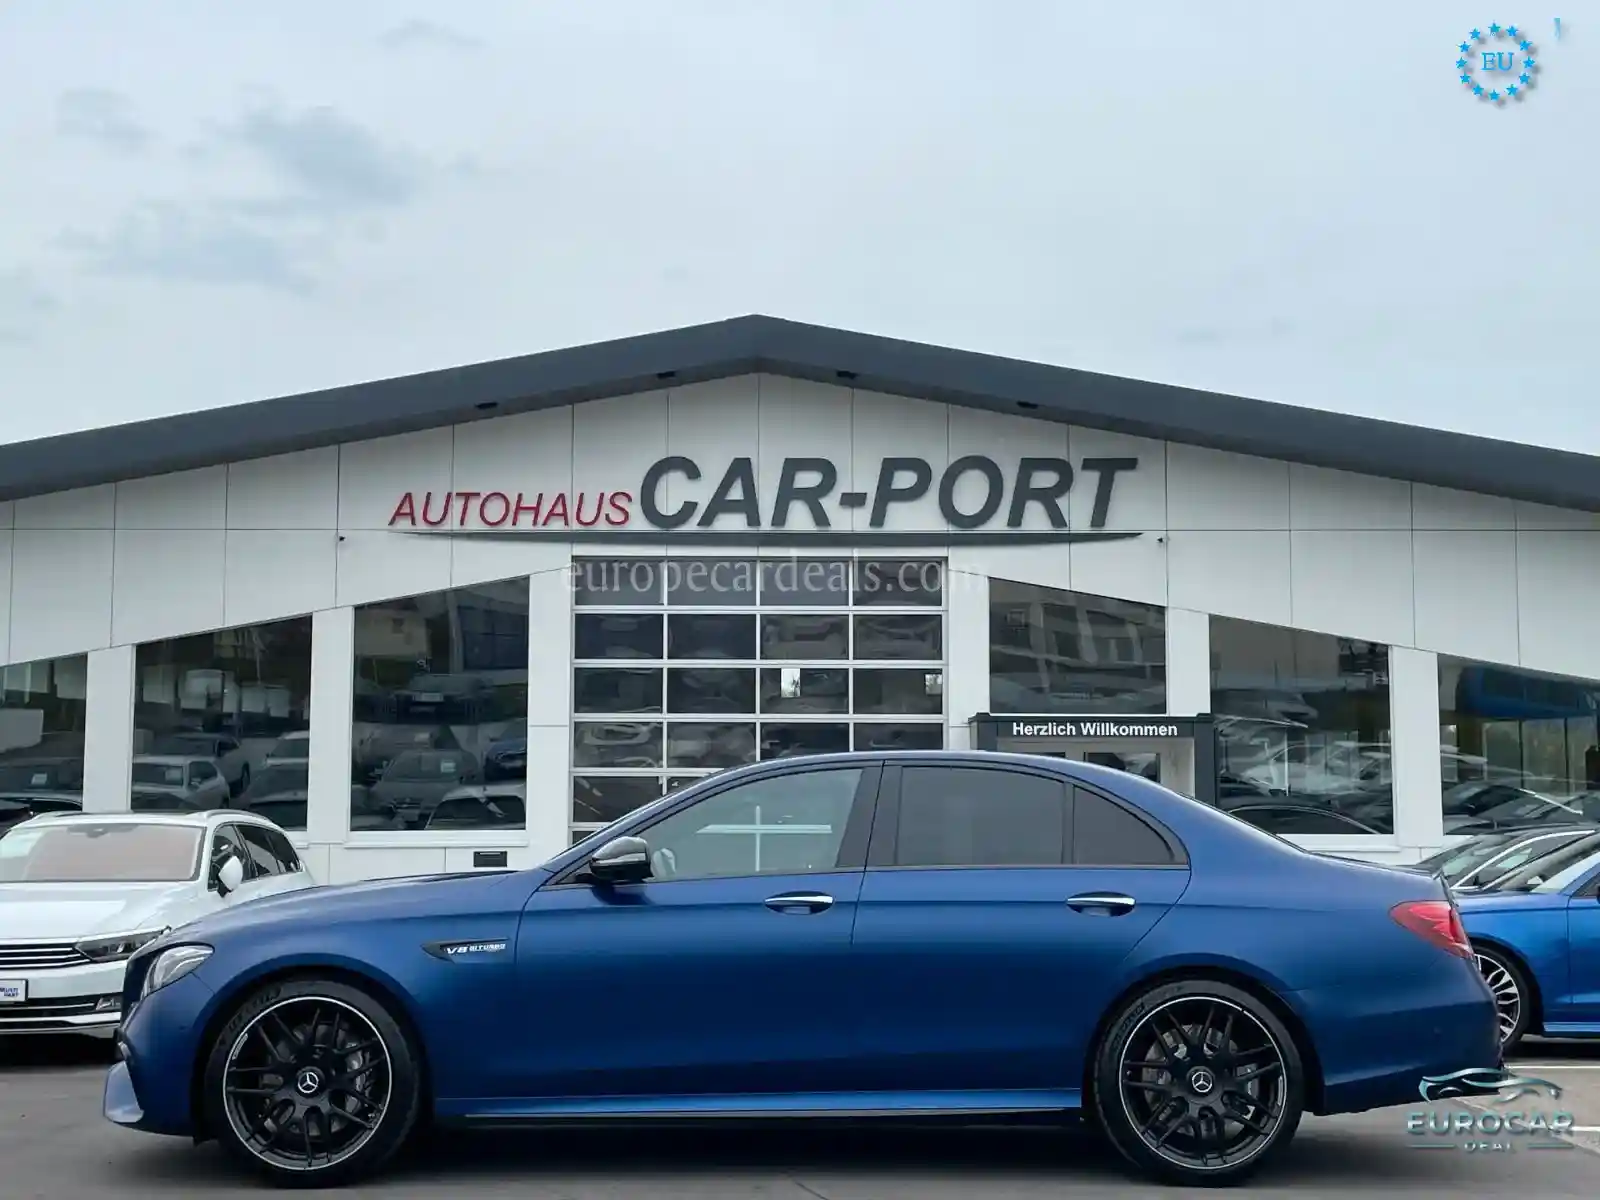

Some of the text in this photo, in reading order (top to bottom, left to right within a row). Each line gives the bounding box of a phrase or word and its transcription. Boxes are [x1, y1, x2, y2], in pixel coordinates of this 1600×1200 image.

[388, 455, 1138, 529] AUTOHAUS CAR-PORT
[1012, 721, 1178, 736] Herzlich Willkommen
[446, 946, 468, 954] V8
